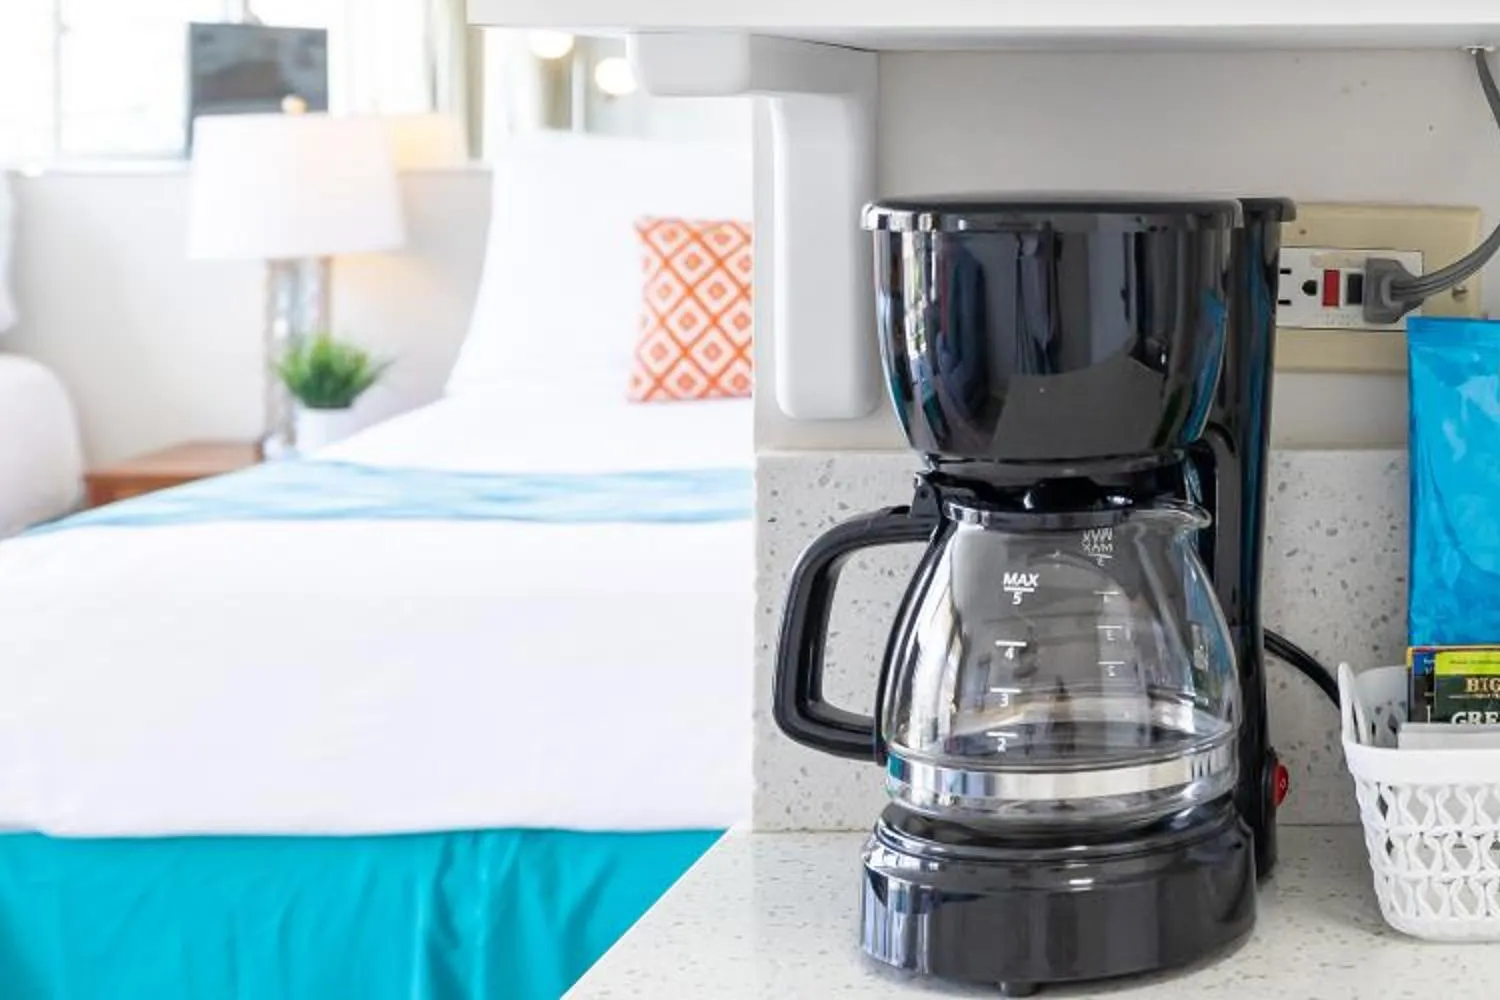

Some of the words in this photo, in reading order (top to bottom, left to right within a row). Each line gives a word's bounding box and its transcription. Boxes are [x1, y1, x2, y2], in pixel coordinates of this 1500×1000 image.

[1003, 572, 1040, 587] MAX
[1012, 592, 1022, 605] 5
[1004, 646, 1015, 660] 4
[1001, 693, 1010, 708] 3
[999, 738, 1008, 753] 2
